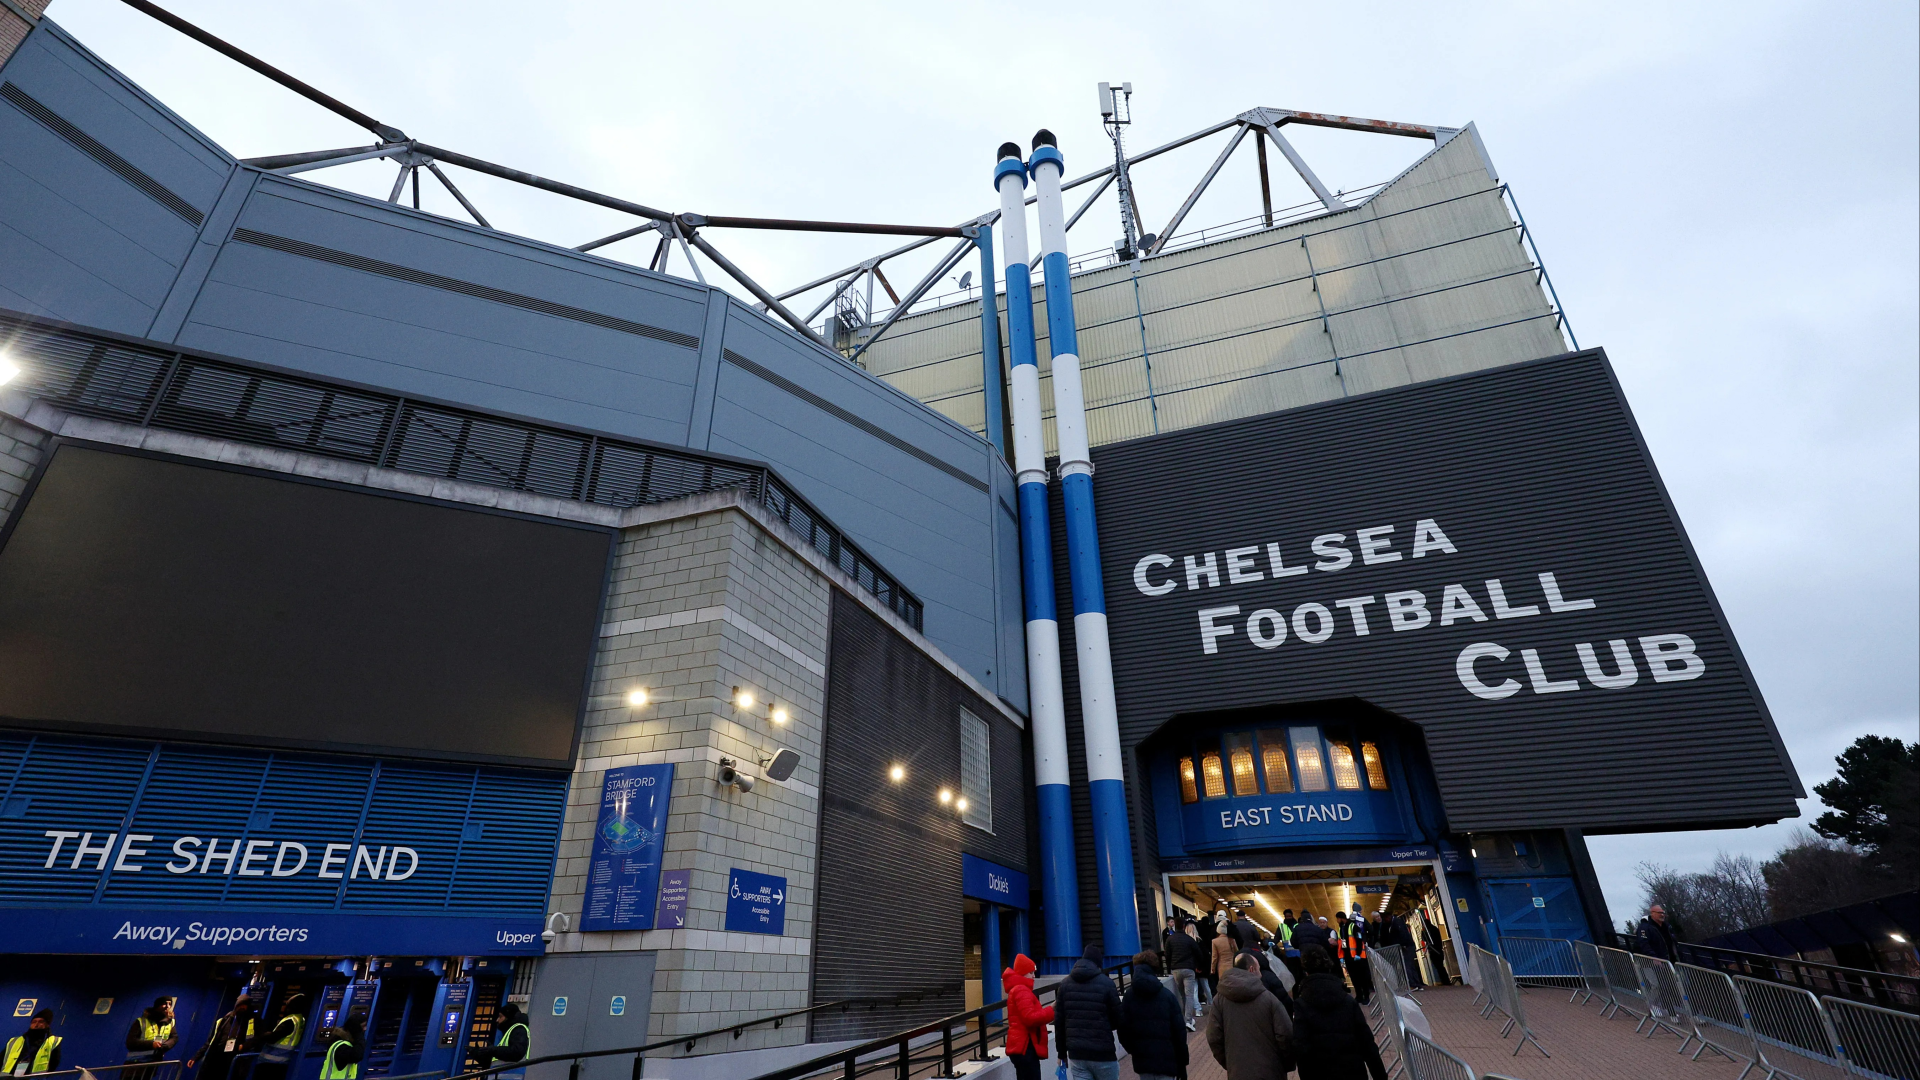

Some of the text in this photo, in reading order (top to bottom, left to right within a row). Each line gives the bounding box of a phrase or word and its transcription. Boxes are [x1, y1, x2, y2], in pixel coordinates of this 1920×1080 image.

[1133, 518, 1458, 597] CHELSEA
[1198, 571, 1596, 655] FOOTBALL
[1456, 633, 1706, 700] CLUB
[606, 777, 656, 791] STAMFORD
[605, 788, 638, 801] BRIDGE
[1220, 803, 1353, 829] EAST STAND
[44, 830, 419, 881] THE SHED END
[1391, 849, 1428, 859] Upper Tier
[988, 872, 1009, 894] Dickie's
[662, 887, 687, 895] Supporters
[760, 886, 772, 895] AWAY
[742, 892, 771, 904] SUPPORTERS
[666, 903, 679, 911] Entry
[751, 906, 770, 915] Accessible
[760, 915, 770, 924] Entry
[113, 921, 309, 946] Away Supporters
[496, 930, 537, 946] Upper
